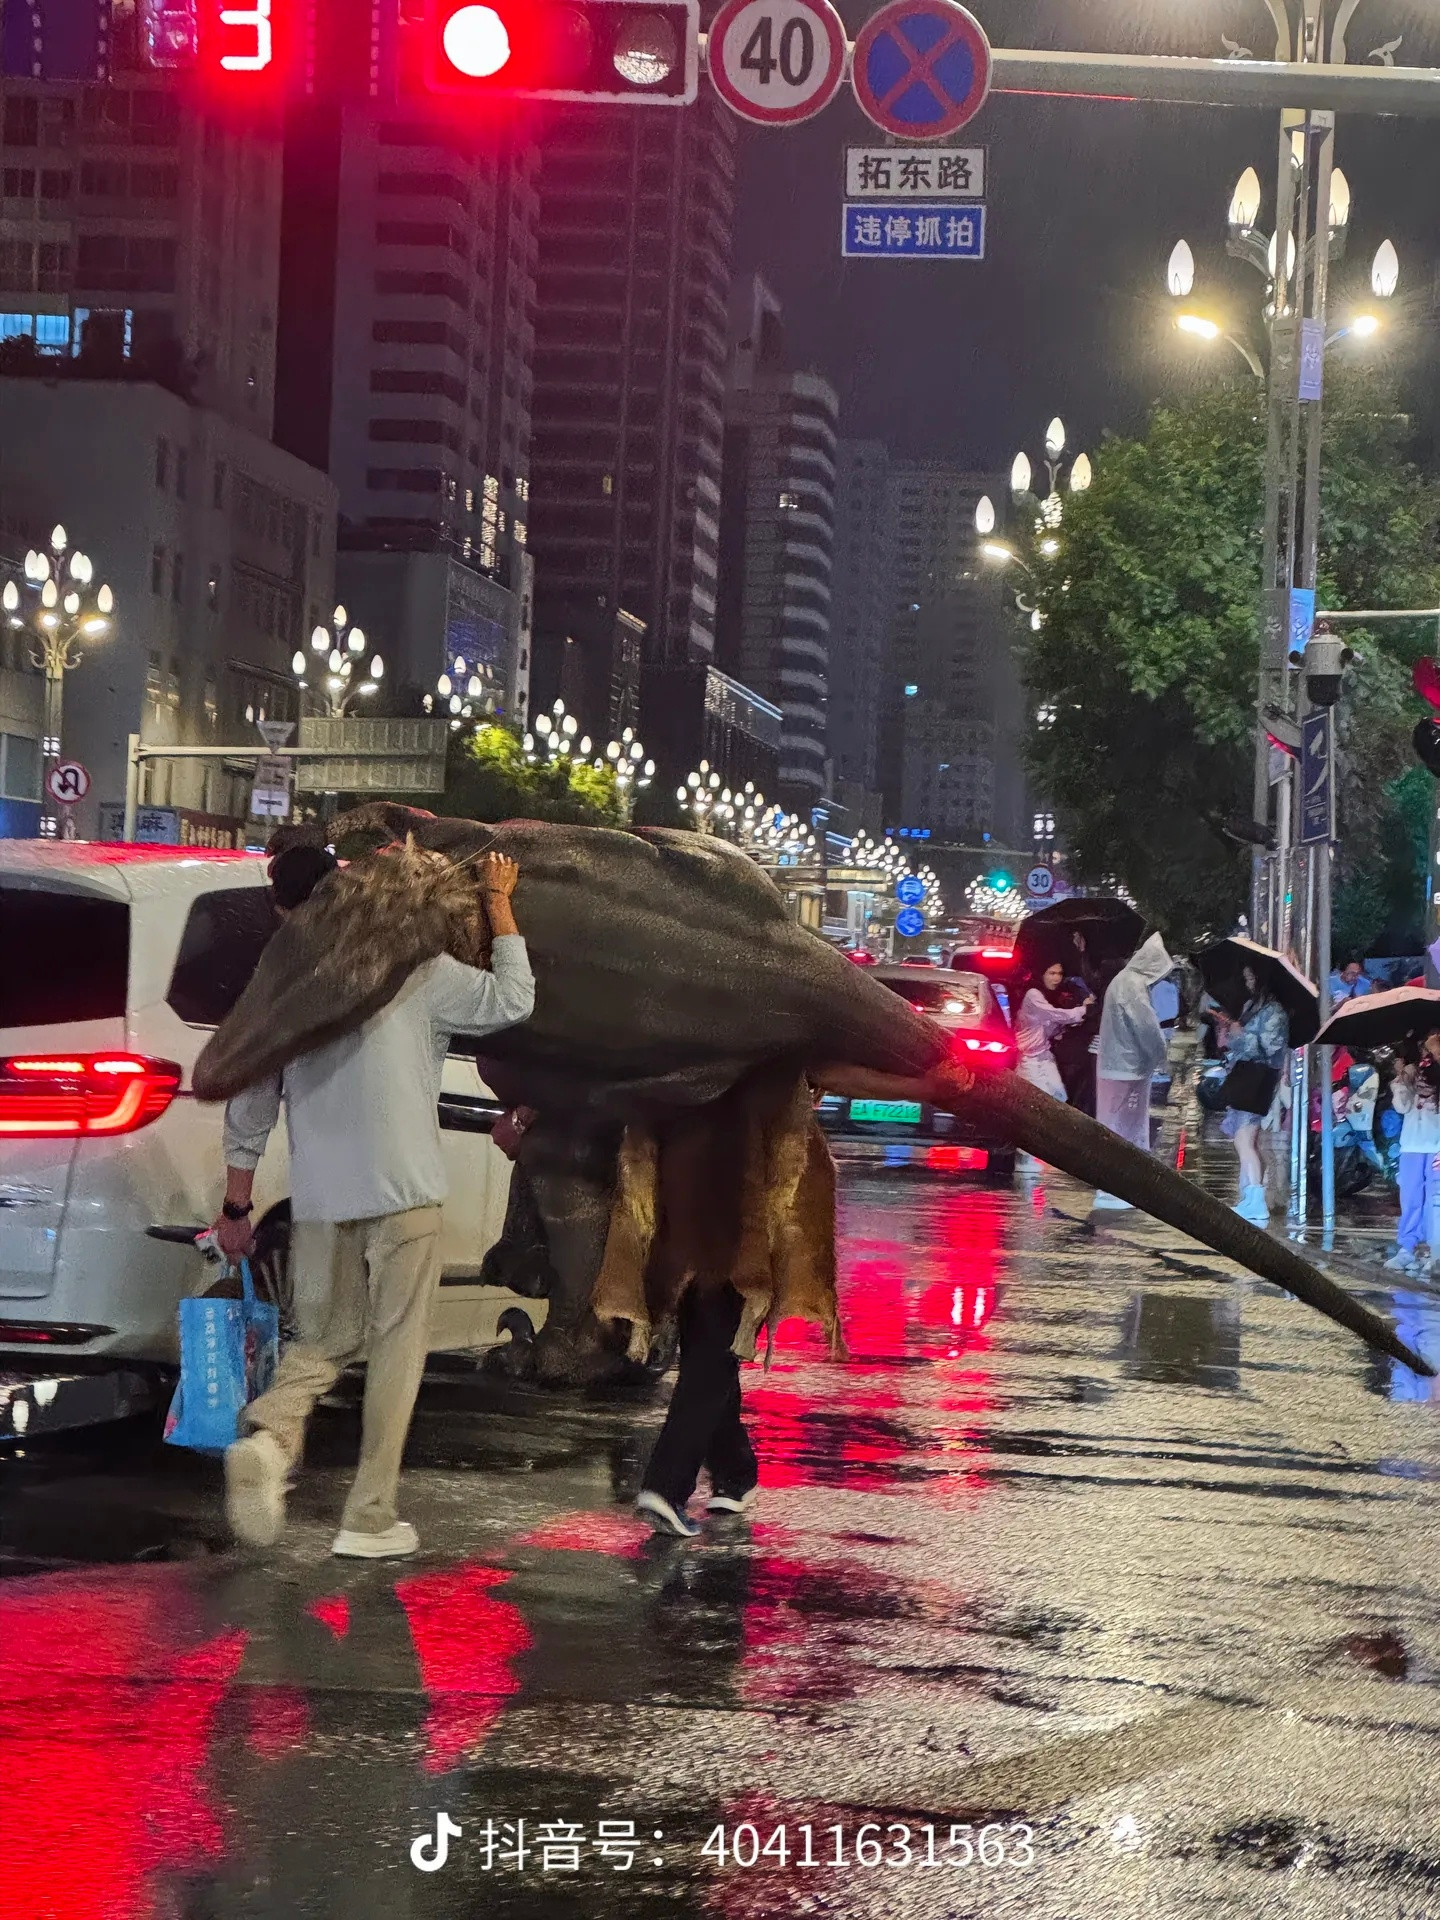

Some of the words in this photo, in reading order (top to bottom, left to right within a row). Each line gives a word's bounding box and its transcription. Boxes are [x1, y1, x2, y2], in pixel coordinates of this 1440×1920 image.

[740, 16, 814, 86] 40
[858, 155, 973, 190] 拓东路
[854, 215, 974, 248] 违停抓拍
[1031, 873, 1049, 888] 30
